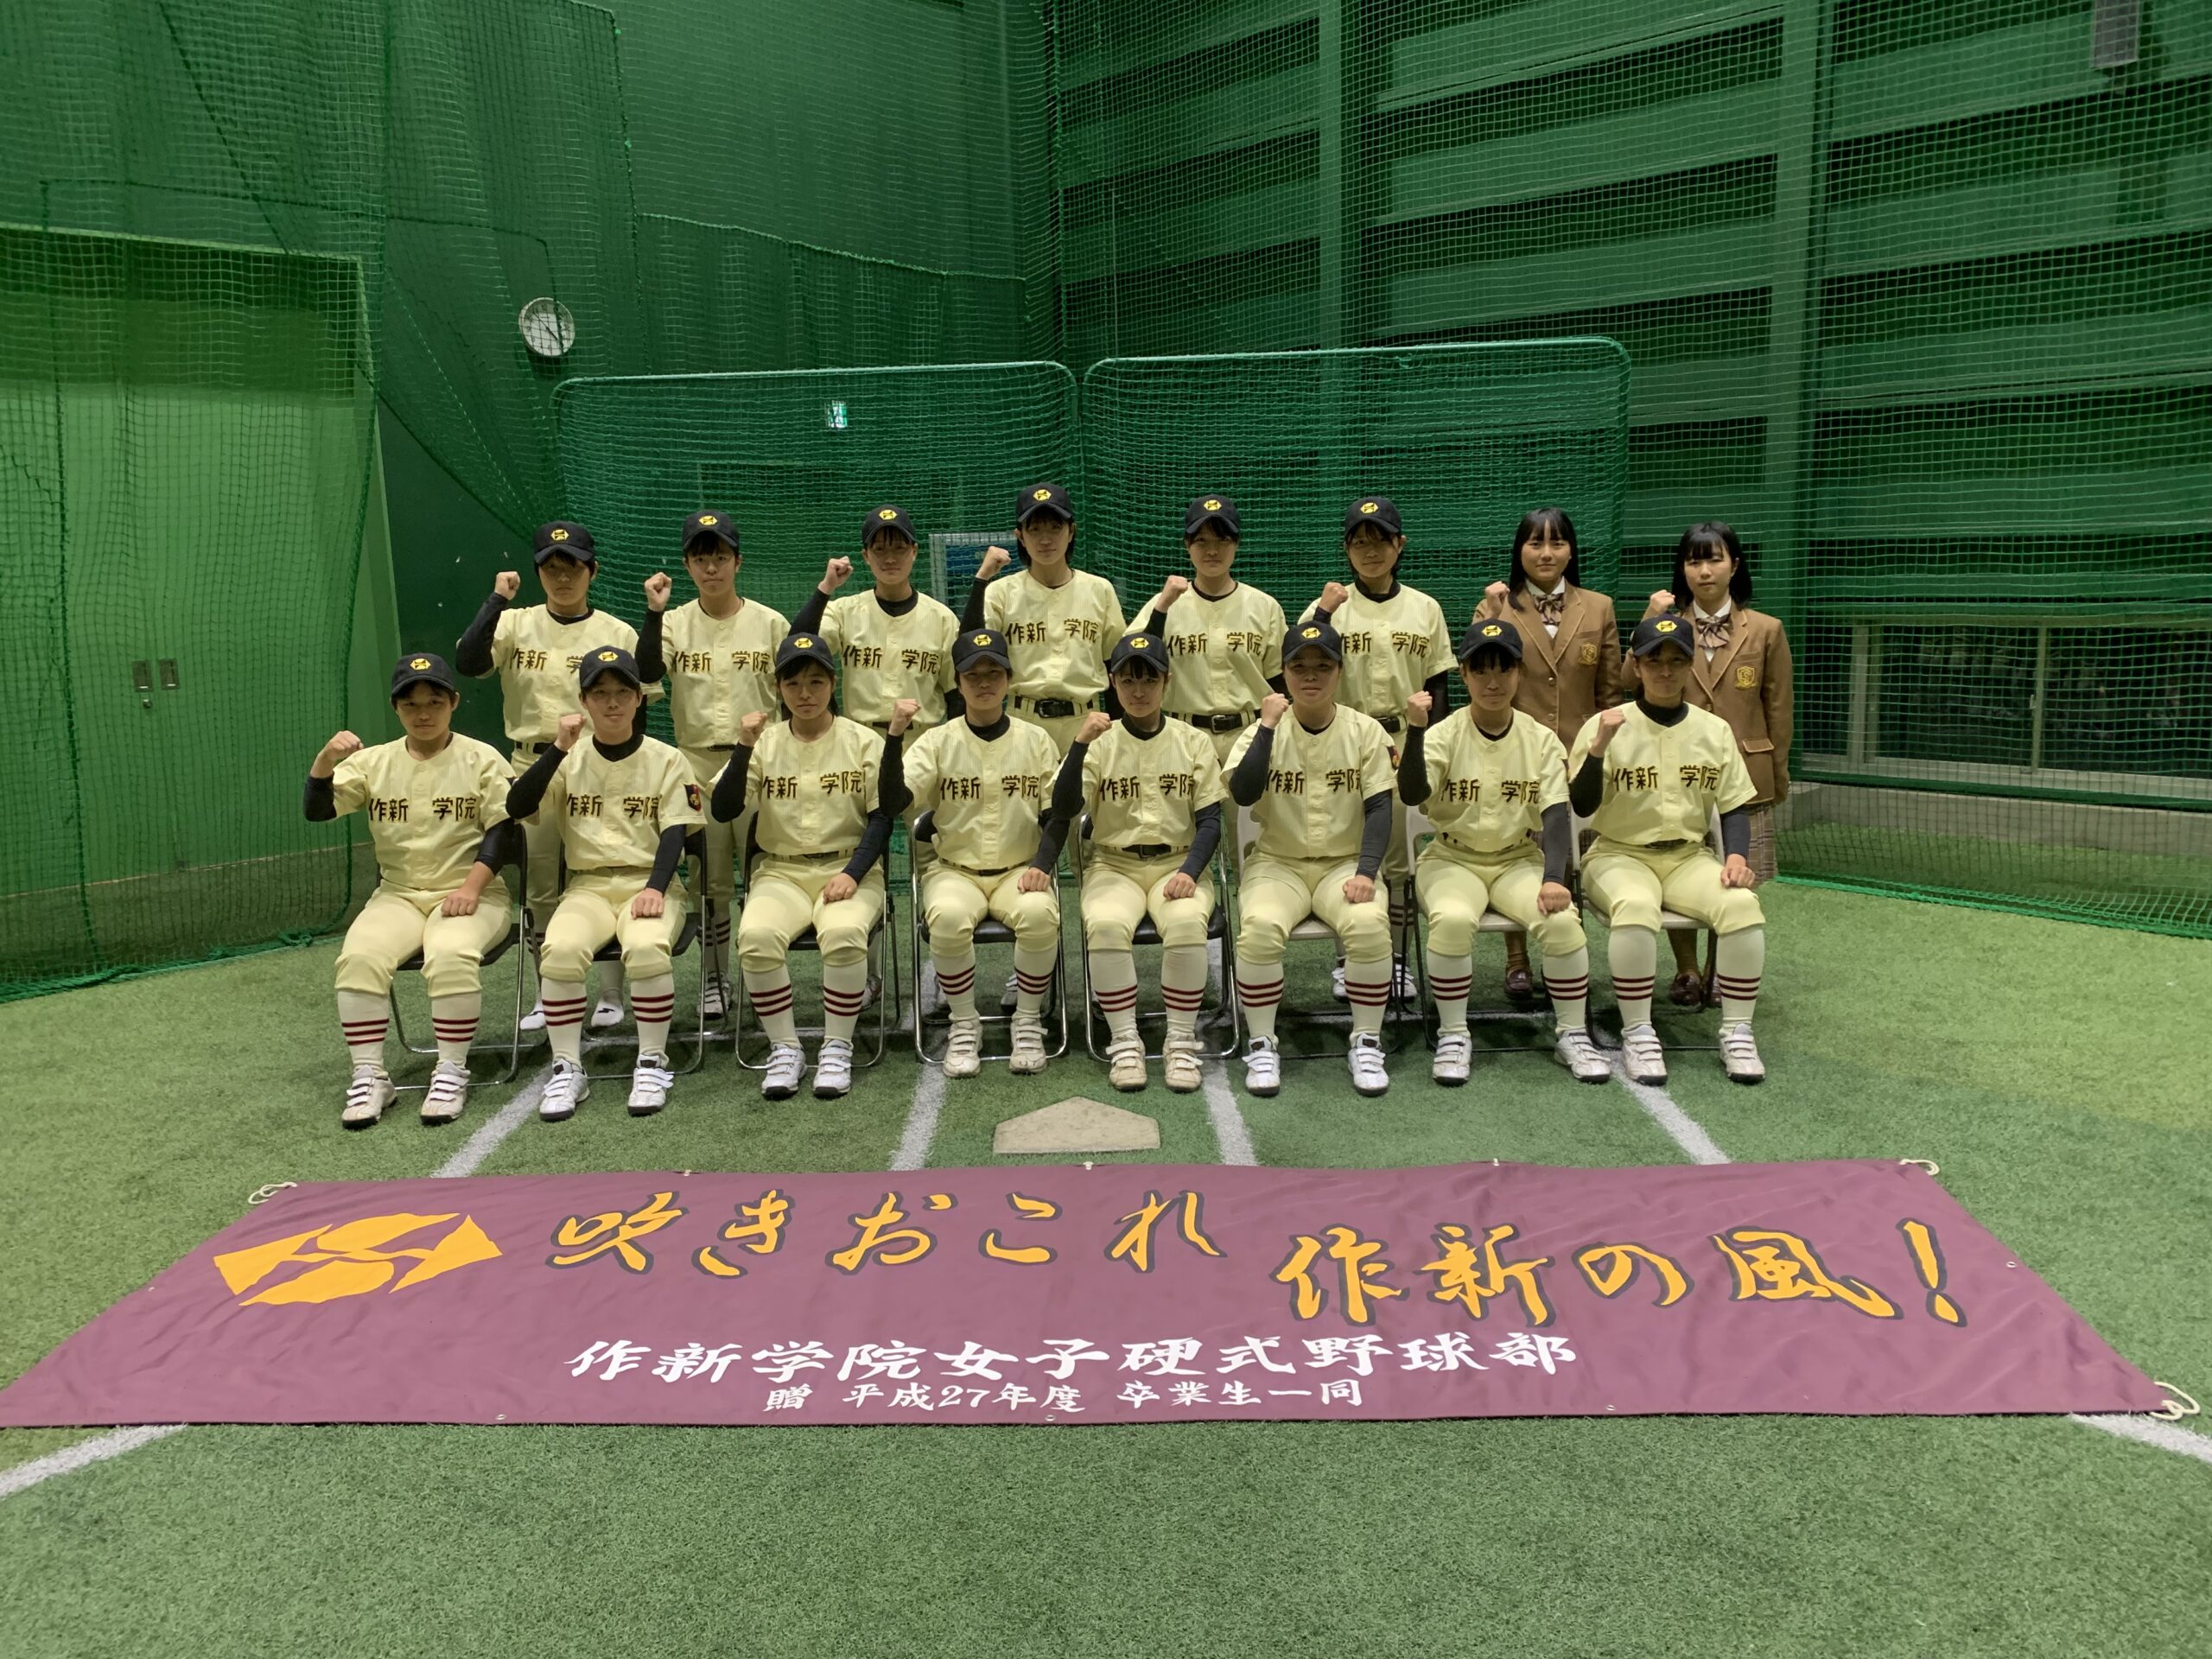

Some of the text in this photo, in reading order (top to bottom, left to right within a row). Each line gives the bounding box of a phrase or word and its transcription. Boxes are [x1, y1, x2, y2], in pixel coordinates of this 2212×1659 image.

[1005, 618, 1099, 645] 作新 学院
[1167, 632, 1263, 657] 作新 学院
[1391, 632, 1430, 658] 学院
[566, 655, 582, 674] 学
[672, 651, 771, 674] 作新 学院
[843, 645, 940, 674] 作新 学院
[820, 770, 863, 795] 学院
[940, 775, 1039, 800] 作新 学院
[1100, 776, 1140, 801] 作新
[1613, 764, 1720, 791] 作新 学院
[1501, 780, 1540, 804] 学院
[369, 797, 477, 822] 作新 学院
[550, 1188, 1223, 1279] 吹きおこれ
[564, 1332, 1577, 1382] 作新学院女子硬式野球部
[764, 1379, 1363, 1413] 贈 平成27年度 卒業生一同
